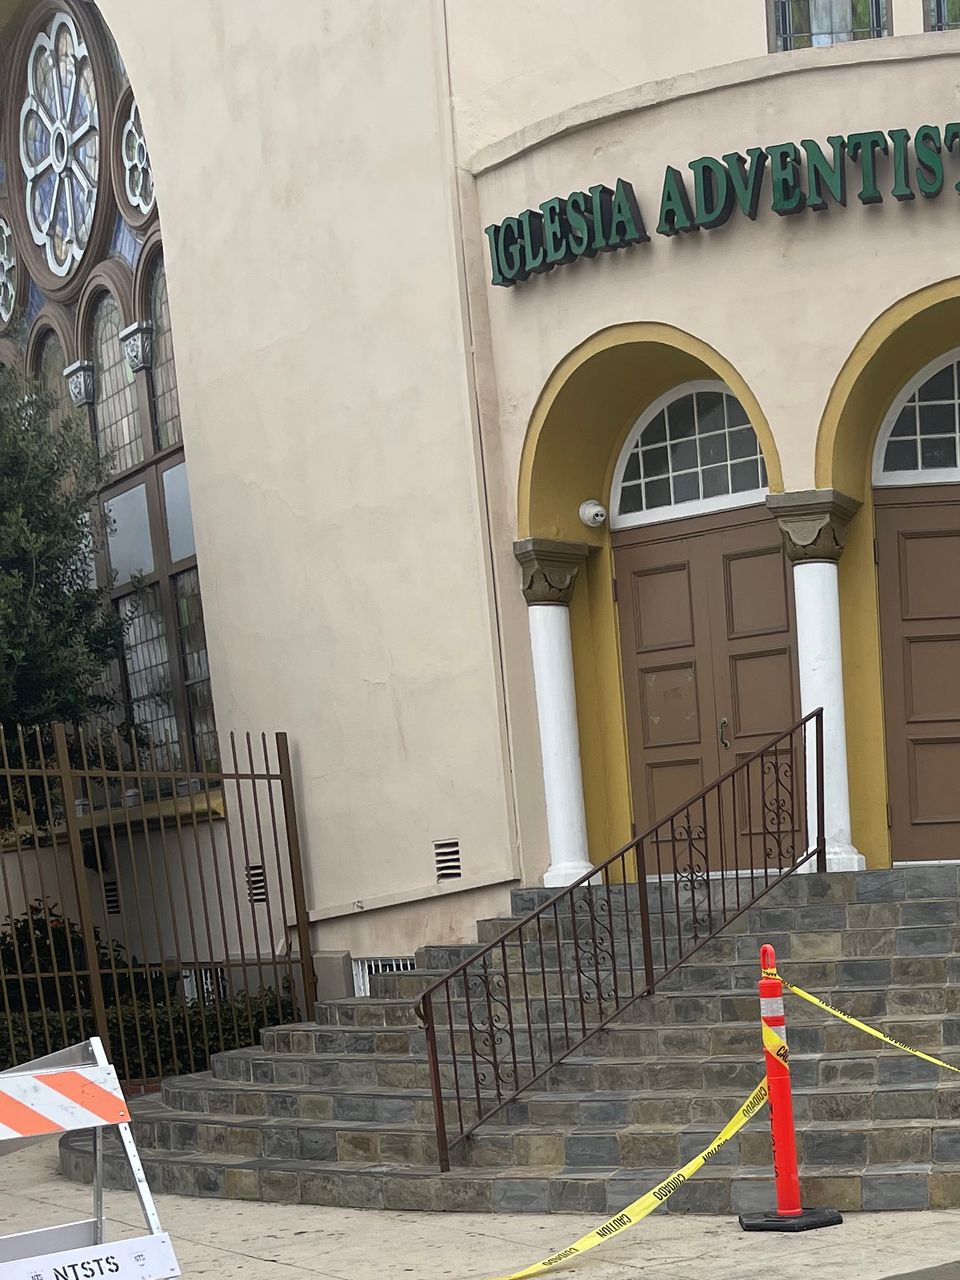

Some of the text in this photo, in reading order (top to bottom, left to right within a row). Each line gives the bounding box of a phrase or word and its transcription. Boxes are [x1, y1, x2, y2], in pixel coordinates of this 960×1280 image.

[484, 178, 651, 287] IGLESIA
[742, 1086, 767, 1118] CUIDADO
[652, 1173, 686, 1201] CUIDADO
[595, 1213, 632, 1238] CAUTION
